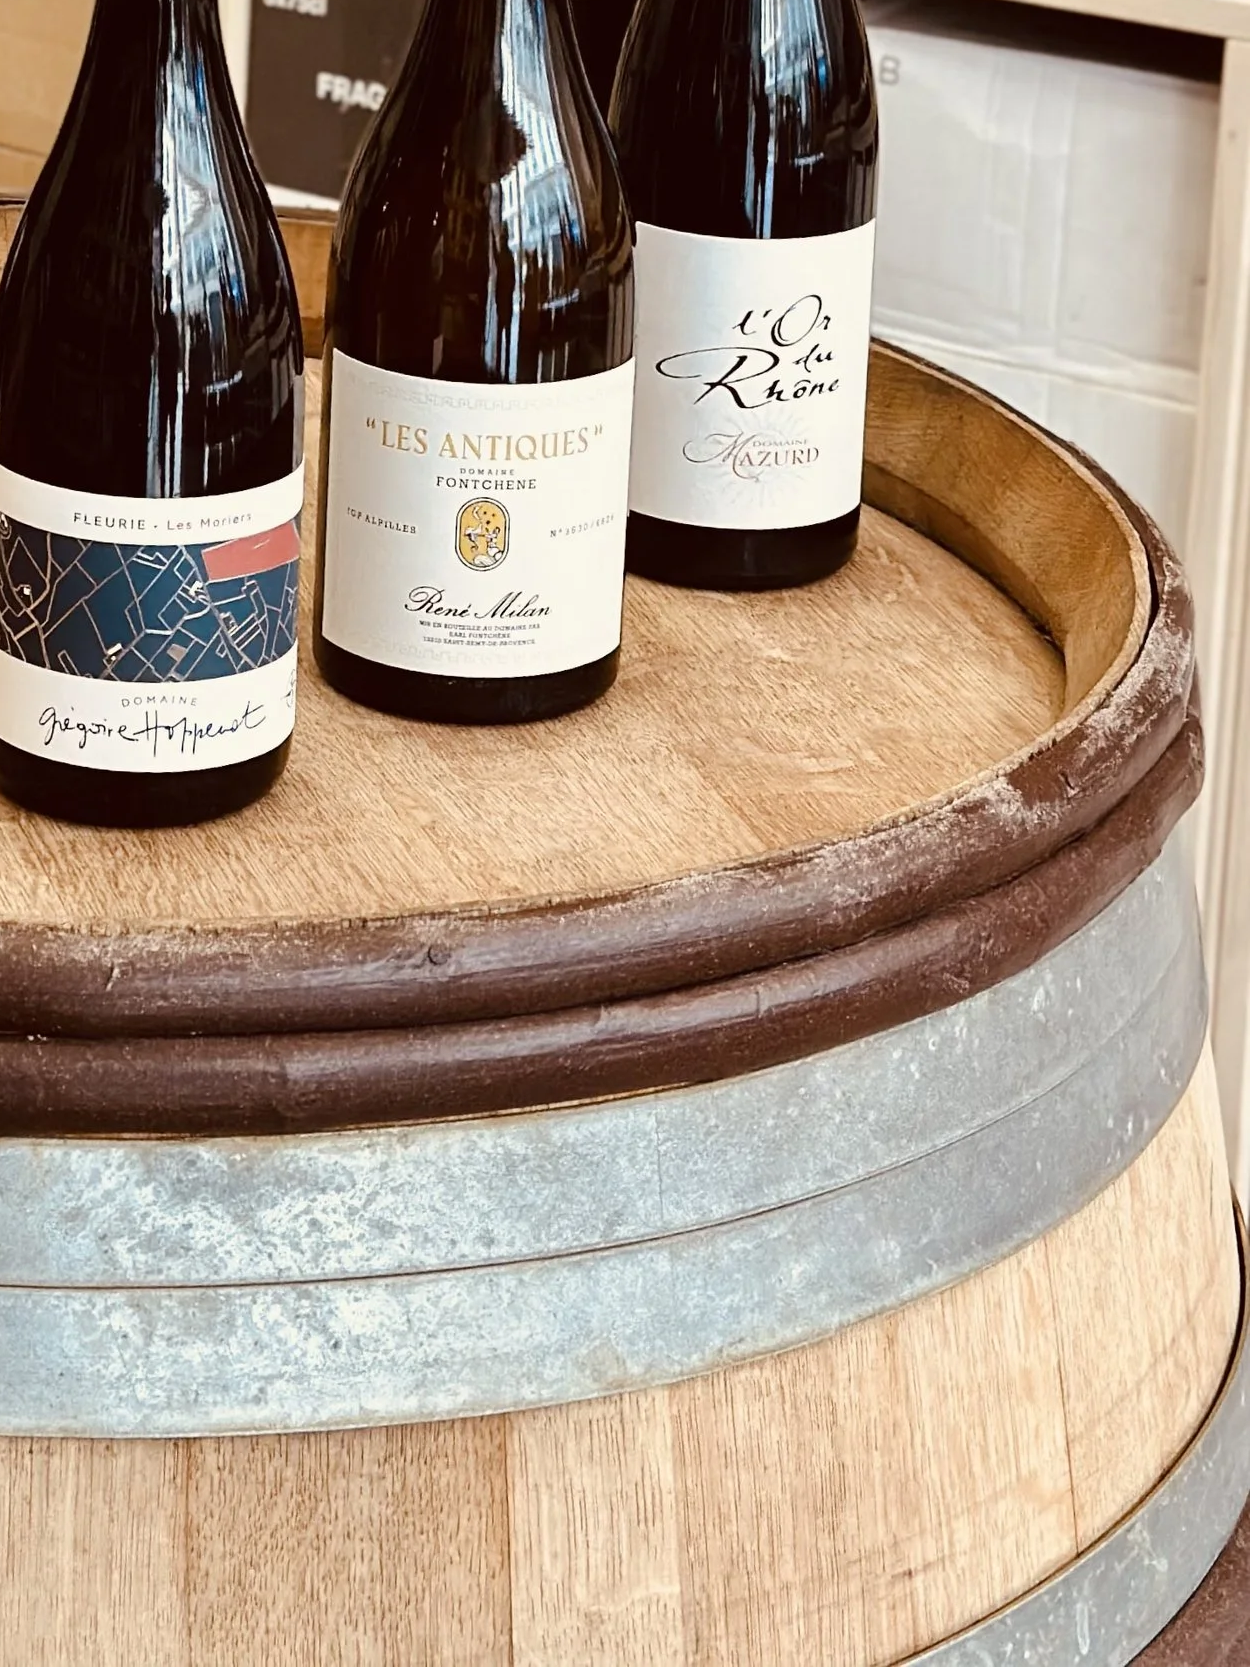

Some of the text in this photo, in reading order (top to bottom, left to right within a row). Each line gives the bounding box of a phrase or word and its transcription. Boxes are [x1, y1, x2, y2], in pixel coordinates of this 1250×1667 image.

[731, 293, 832, 348] l'Or
[791, 342, 834, 373] du
[654, 346, 840, 410] Rhône
[681, 430, 820, 484] MAZURD
[435, 476, 537, 491] FONTCHENE
[459, 467, 516, 476] DOMAINE
[72, 511, 147, 532] FLEURIE
[166, 518, 193, 532] Les
[199, 512, 253, 529] Moriers
[364, 514, 417, 535] ALPILLES
[403, 585, 553, 620] René Milan
[120, 695, 199, 709] DOMAINE
